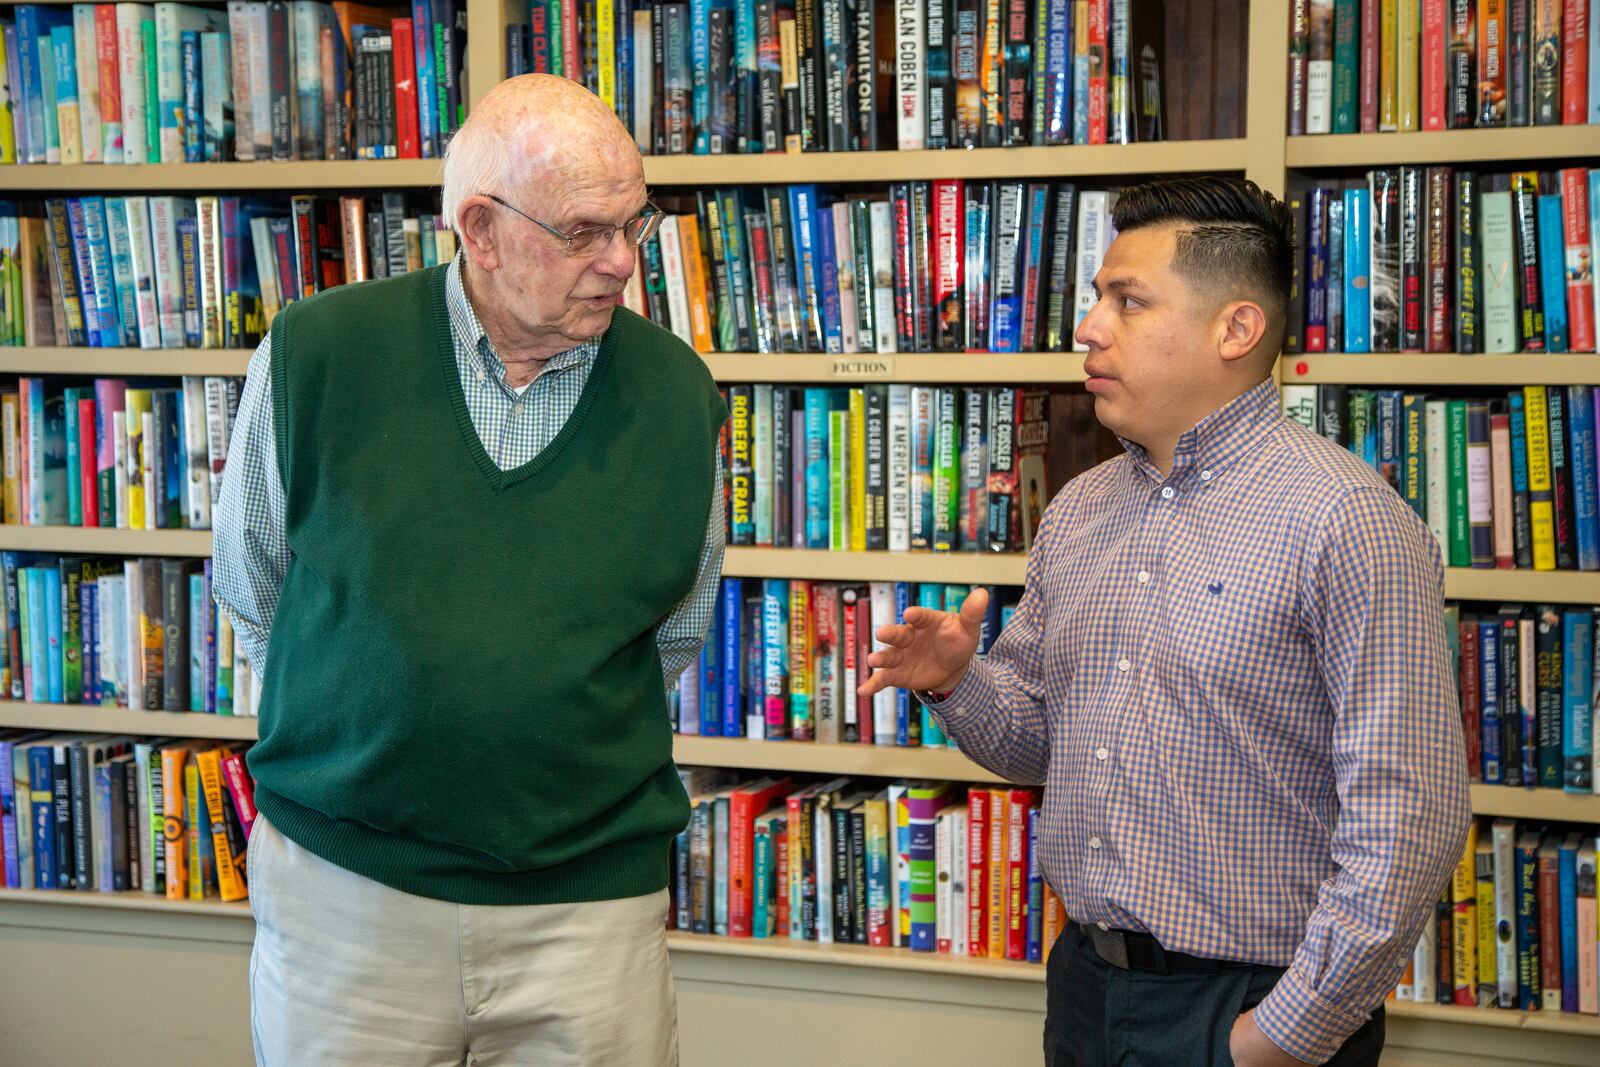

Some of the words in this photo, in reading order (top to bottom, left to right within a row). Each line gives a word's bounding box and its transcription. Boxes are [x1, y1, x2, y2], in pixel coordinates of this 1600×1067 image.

[532, 6, 545, 33] TOM
[900, 0, 916, 35] RLAN
[534, 37, 546, 73] CLAN
[695, 29, 705, 86] CLEEVES
[737, 26, 747, 78] CLEEVES
[857, 12, 871, 111] HAMILTON
[900, 42, 916, 91] COBEN
[902, 95, 915, 119] HOME
[940, 186, 958, 235] PATRICIA
[999, 186, 1017, 235] PATRICIA
[1057, 192, 1072, 232] PATRICIA
[1404, 221, 1416, 264] FLYNN
[1433, 267, 1443, 284] THE
[997, 304, 1013, 329] dust
[1433, 287, 1444, 307] LAST
[1433, 310, 1444, 332] MAN
[833, 362, 888, 373] FICTION
[208, 381, 221, 416] STEVE
[870, 407, 881, 415] A
[942, 393, 953, 422] CLIVE
[968, 393, 981, 426] CLIVE
[998, 392, 1011, 423] CLIVE
[1301, 397, 1314, 429] LETH
[1530, 394, 1542, 421] TESS
[732, 395, 748, 461] ROBERT
[775, 393, 784, 445] POCKET
[870, 419, 881, 459] COLDER
[1408, 410, 1418, 453] ALISON
[1452, 407, 1464, 432] Lisa
[894, 425, 906, 488] AMERICAN
[941, 424, 953, 469] CUSSLER
[968, 427, 980, 477] CUSSLER
[997, 424, 1011, 471] CUSSLER
[1454, 433, 1466, 477] Genova
[1531, 425, 1546, 486] GERRITSEN
[870, 463, 881, 487] WAR
[1408, 456, 1418, 499] GAYLIN
[733, 476, 748, 524] CRAIS
[895, 493, 906, 520] DIRT
[937, 476, 951, 531] MIRAGE
[766, 594, 779, 646] JEFFERY
[793, 591, 805, 639] JEFFERY
[817, 595, 829, 636] DEAVER
[766, 647, 781, 695] DEAVER
[792, 643, 805, 689] DEAVER
[821, 687, 832, 721] creek
[56, 779, 68, 797] THE
[56, 799, 69, 823] PLEA
[679, 852, 687, 872] PAUL
[1523, 863, 1535, 889] Matt
